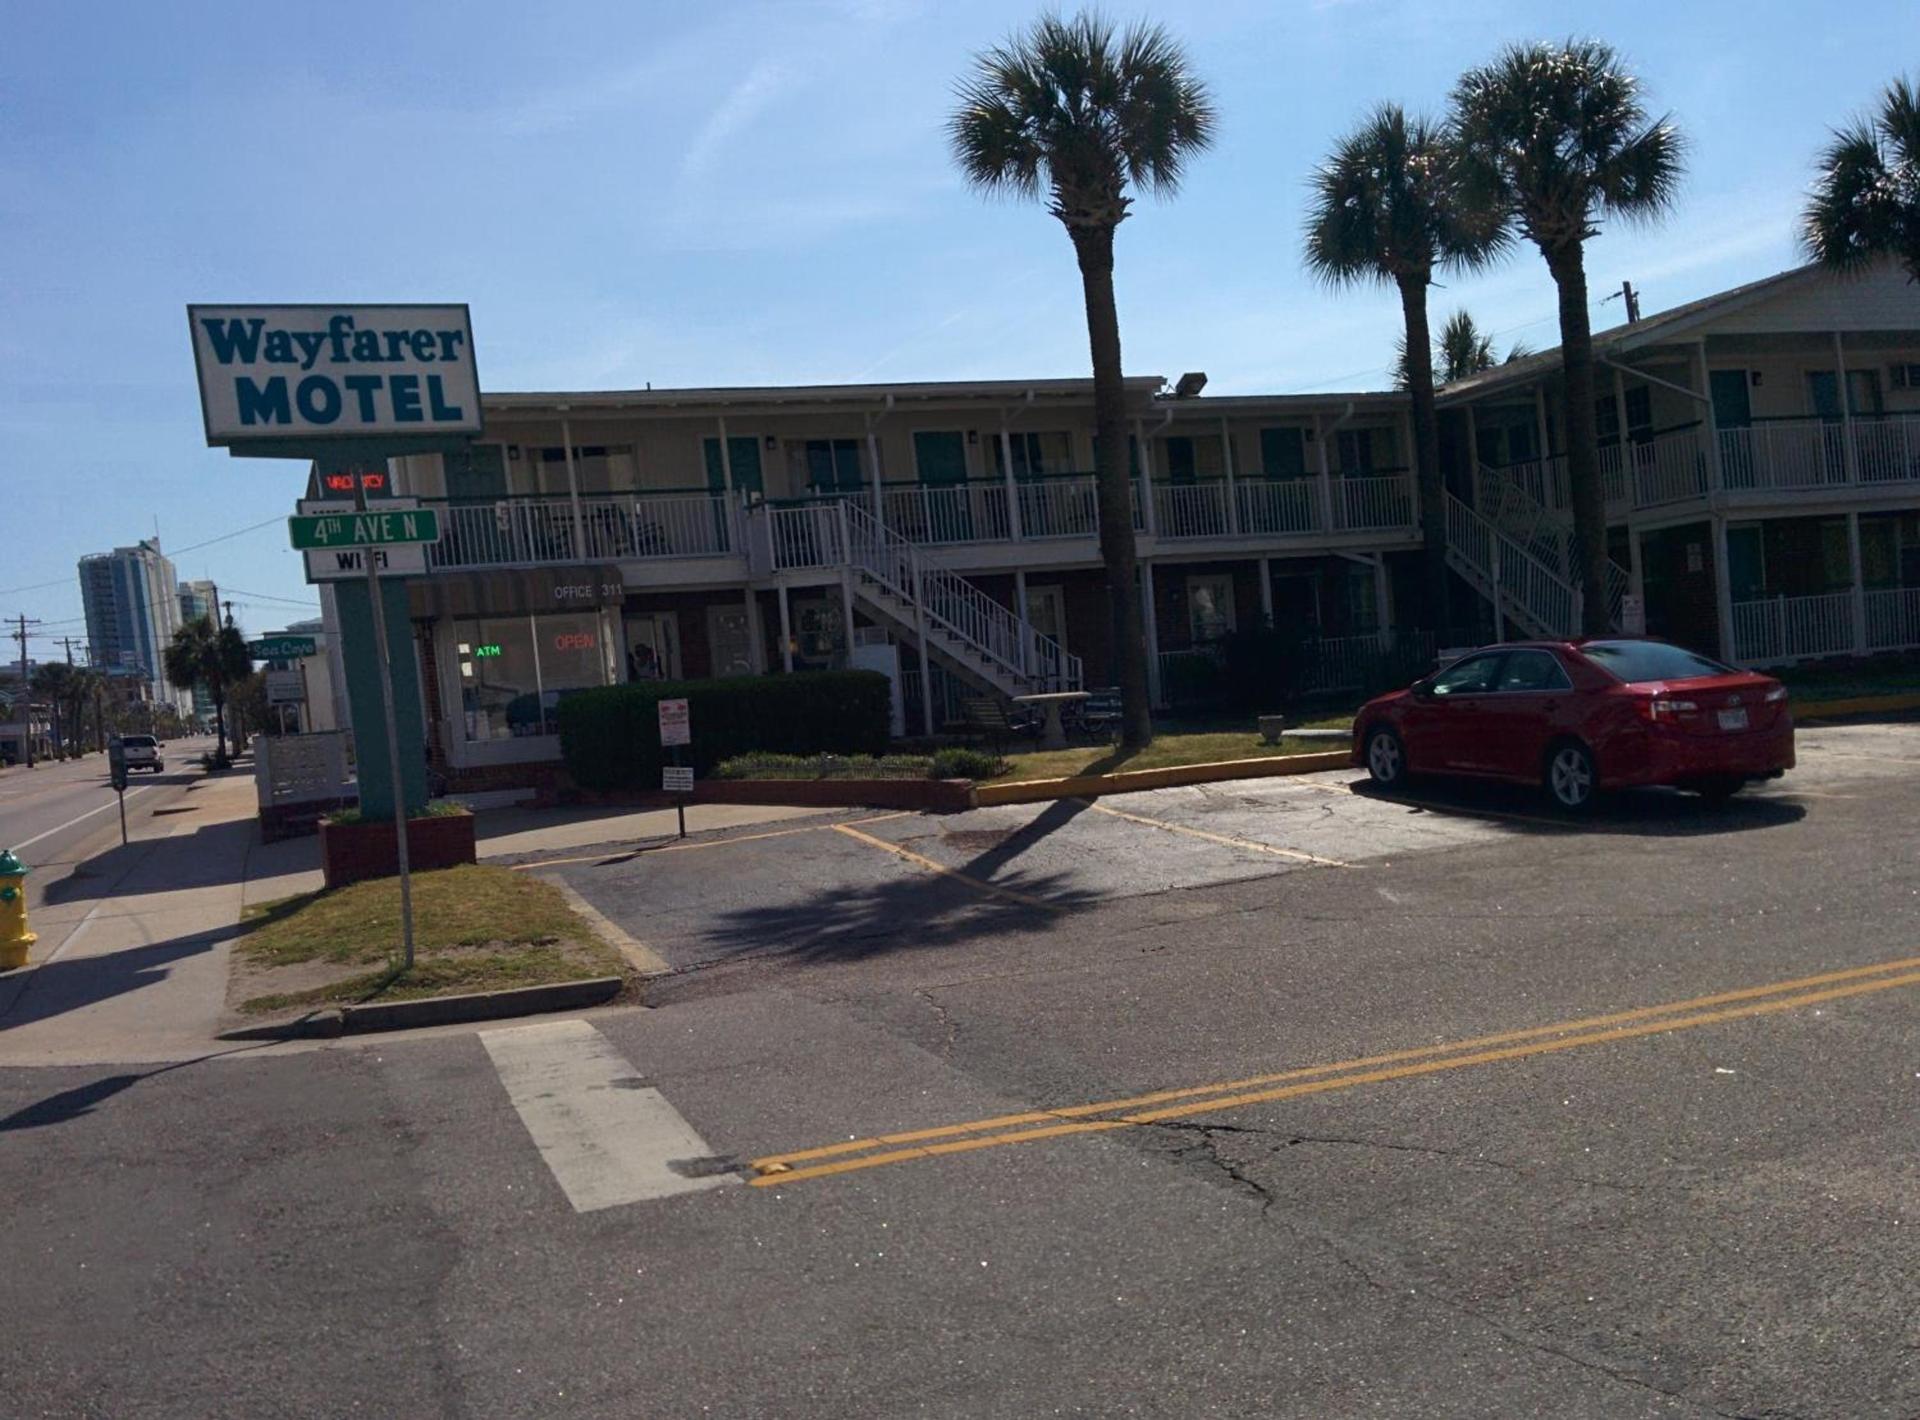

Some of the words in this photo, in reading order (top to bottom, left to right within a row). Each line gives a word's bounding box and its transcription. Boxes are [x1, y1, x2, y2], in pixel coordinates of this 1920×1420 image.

[201, 315, 464, 371] Wayfarer
[235, 374, 464, 426] MOTEL
[326, 474, 384, 490] VACNCY
[314, 517, 342, 543] 4TH
[354, 516, 394, 543] AVE
[403, 514, 418, 539] N
[554, 585, 593, 599] OFFICE
[601, 583, 622, 596] 311
[555, 633, 595, 650] OPEN
[476, 645, 501, 657] ATM
